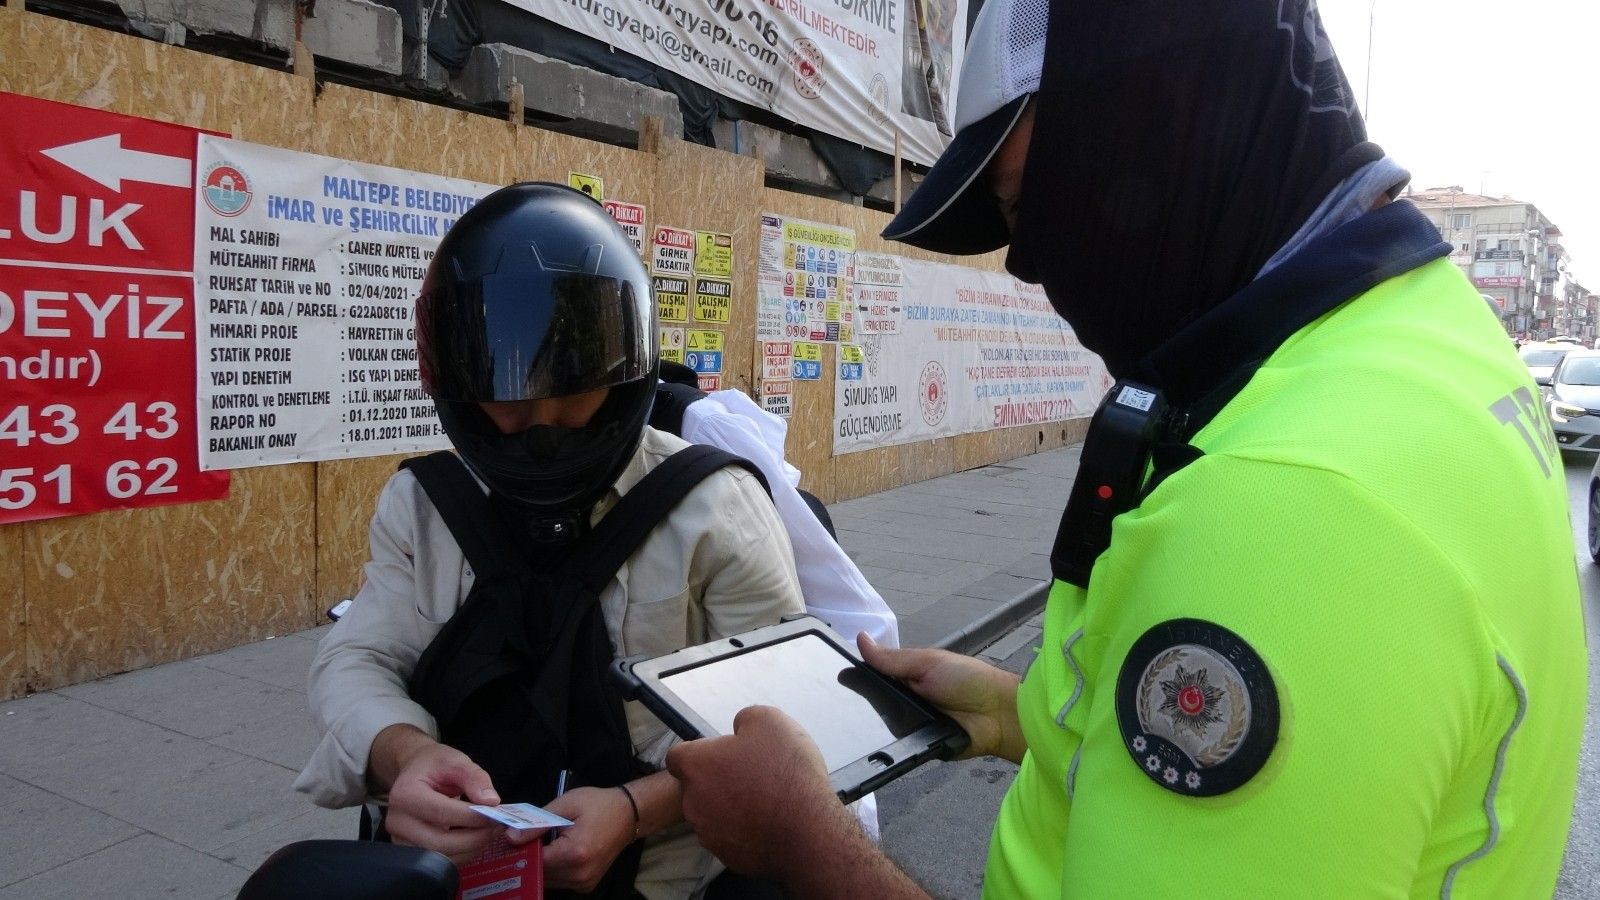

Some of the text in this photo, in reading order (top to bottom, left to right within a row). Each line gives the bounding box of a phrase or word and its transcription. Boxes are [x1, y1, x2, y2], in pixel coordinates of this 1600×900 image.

[323, 175, 400, 207] MALTEPE
[0, 190, 144, 251] UK
[321, 206, 344, 227] ve
[210, 226, 236, 243] MAL
[348, 241, 382, 256] CANER
[385, 244, 420, 260] KURTEL
[424, 250, 435, 260] ve
[660, 247, 688, 260] GİRMEK
[656, 258, 690, 272] YASAKTIR
[209, 275, 258, 293] RUHSAT
[298, 283, 312, 296] ve
[315, 281, 331, 296] NO
[348, 284, 408, 300] 02/04/2021
[209, 299, 248, 315] PAFTA
[260, 301, 285, 316] ADA
[297, 303, 338, 318] PARSEL
[697, 295, 728, 310] ÇALIŞMA
[702, 308, 717, 320] VAR
[261, 324, 298, 340] PROJE
[255, 347, 292, 362] PROJE
[348, 348, 388, 361] VOLKAN
[210, 371, 239, 386] YAPI
[368, 369, 391, 382] YAPI
[211, 393, 259, 410] KONTROL
[263, 395, 275, 407] ve
[277, 391, 330, 407] DENETLEME
[879, 385, 897, 404] YAPI
[0, 401, 179, 447] 43 43
[210, 414, 255, 431] RAPOR
[259, 413, 276, 428] NO
[349, 407, 408, 423] 01.12.2020
[839, 410, 902, 440] GÜÇLENDİRME
[209, 434, 266, 453] BAKANLIK
[268, 432, 298, 448] ONAY
[348, 426, 403, 442] 18.01.2021
[0, 457, 179, 510] 51 62
